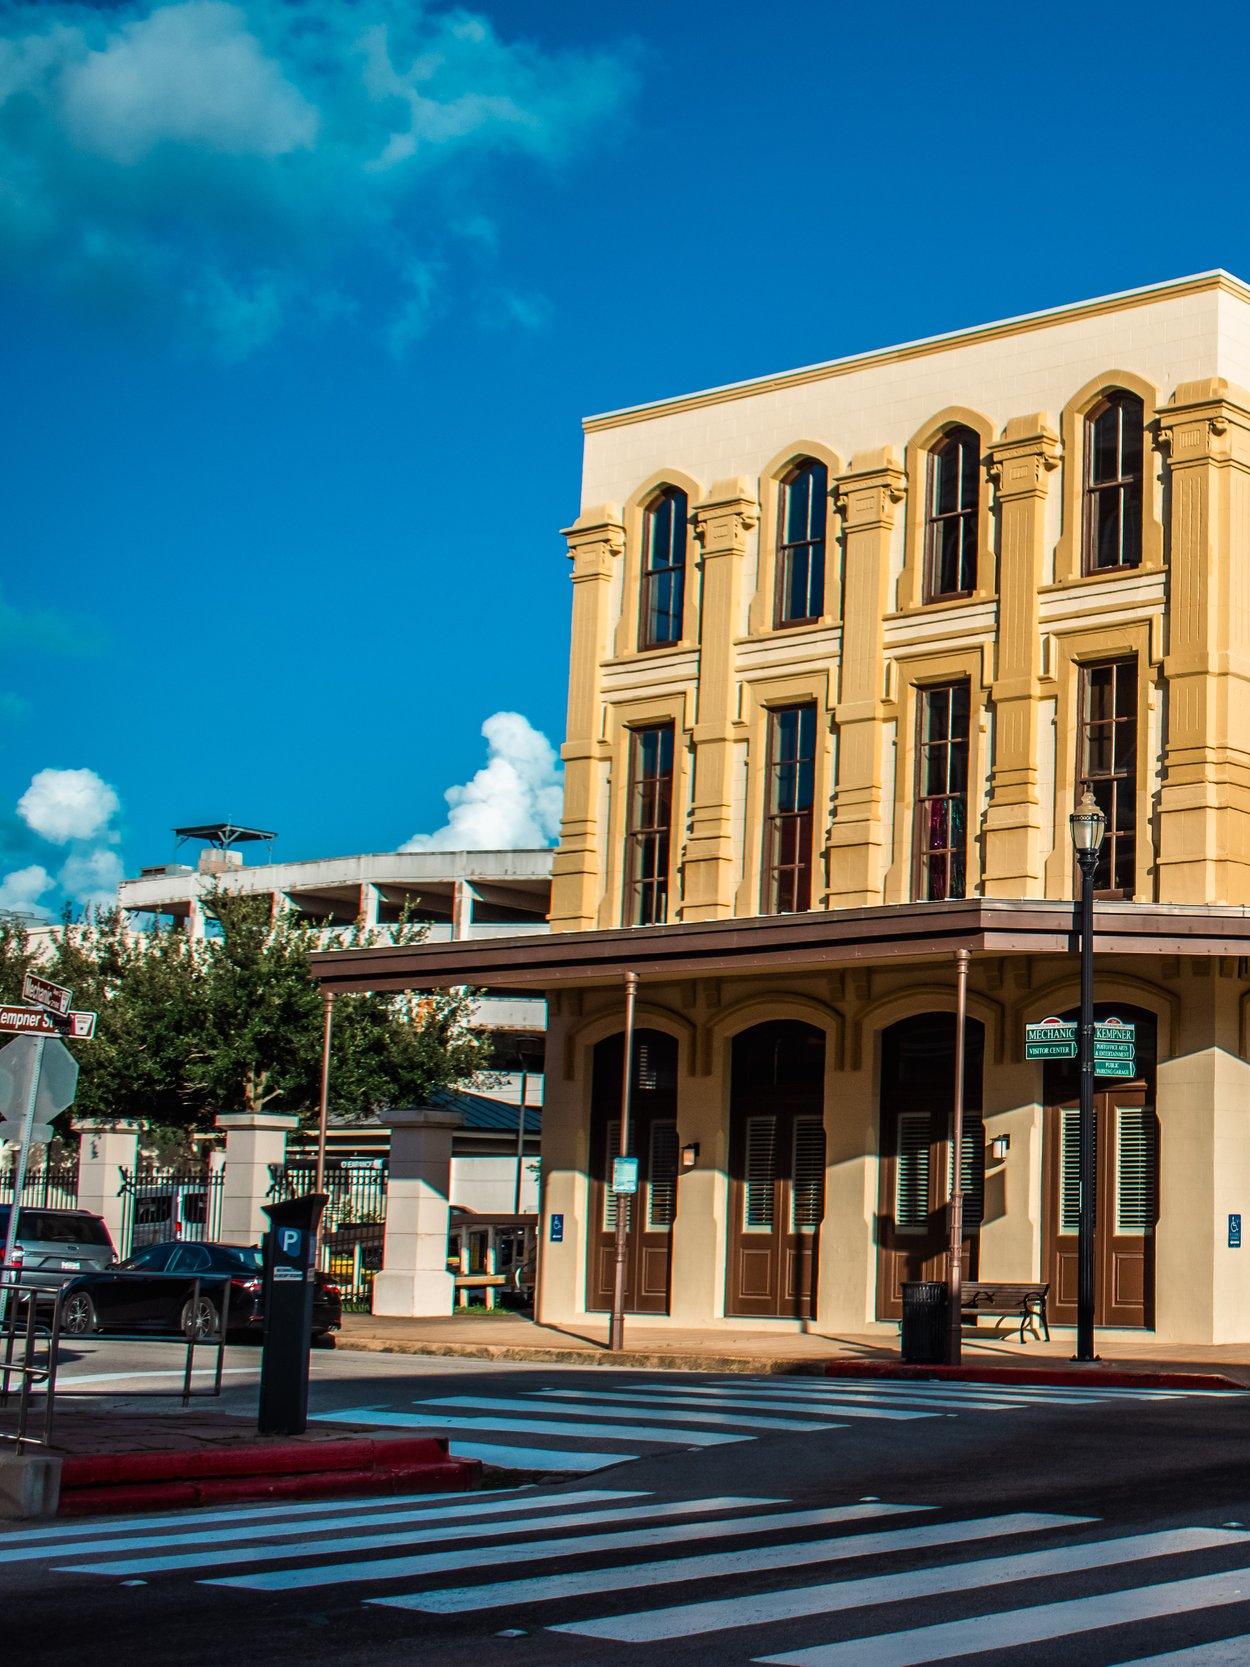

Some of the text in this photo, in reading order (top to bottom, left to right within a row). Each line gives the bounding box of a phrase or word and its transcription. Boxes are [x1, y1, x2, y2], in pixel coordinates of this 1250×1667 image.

[25, 978, 52, 1005] Mechanic
[0, 1008, 41, 1029] empner
[1029, 1029, 1075, 1039] MECHANIC
[1096, 1029, 1131, 1039] KEMPNER
[283, 1231, 298, 1251] P
